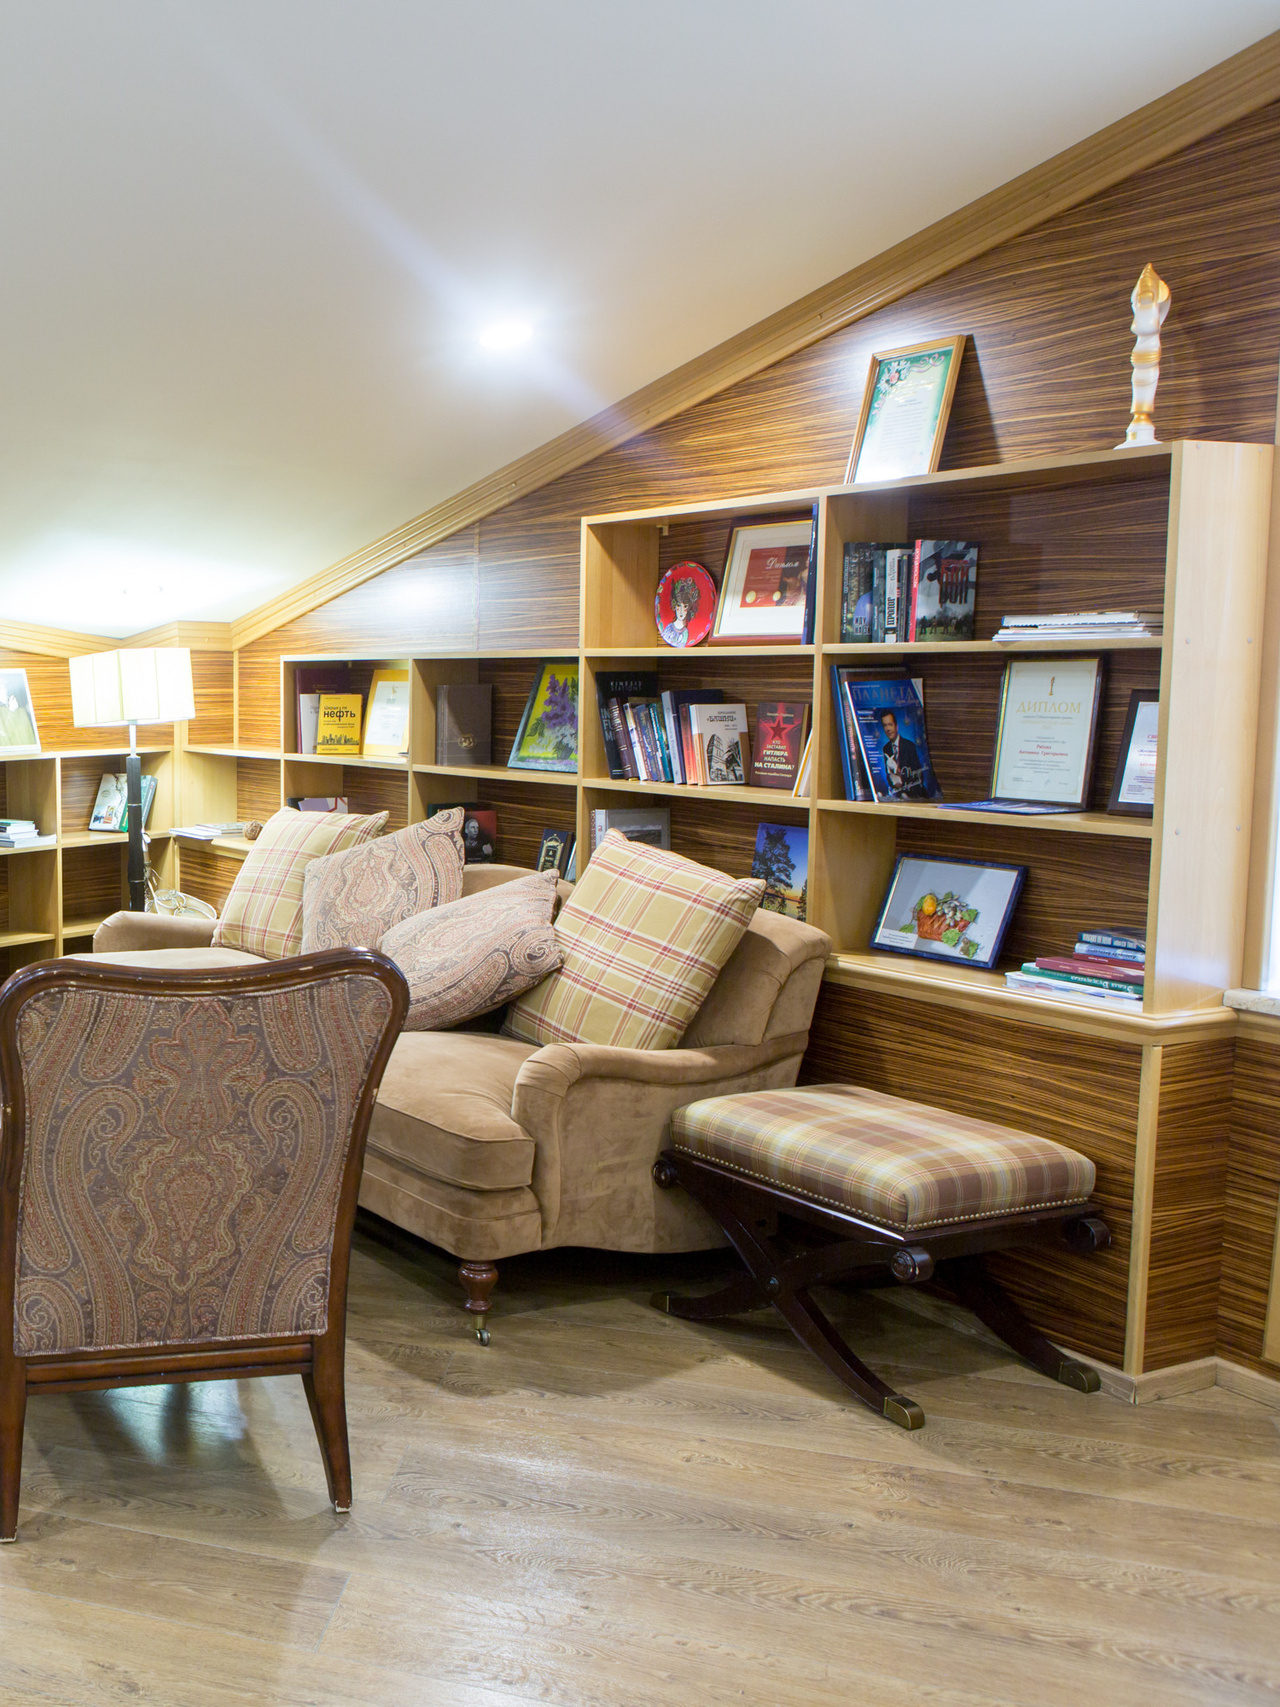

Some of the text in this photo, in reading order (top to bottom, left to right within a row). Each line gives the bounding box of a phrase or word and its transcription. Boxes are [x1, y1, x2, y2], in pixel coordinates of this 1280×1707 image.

[887, 597, 896, 626] ПРОЛОГ
[852, 685, 915, 701] ПЛАНЕТА
[323, 707, 356, 722] нефть
[1016, 701, 1082, 714] ДИПЛОМ
[764, 762, 795, 770] СТАЛИНА?
